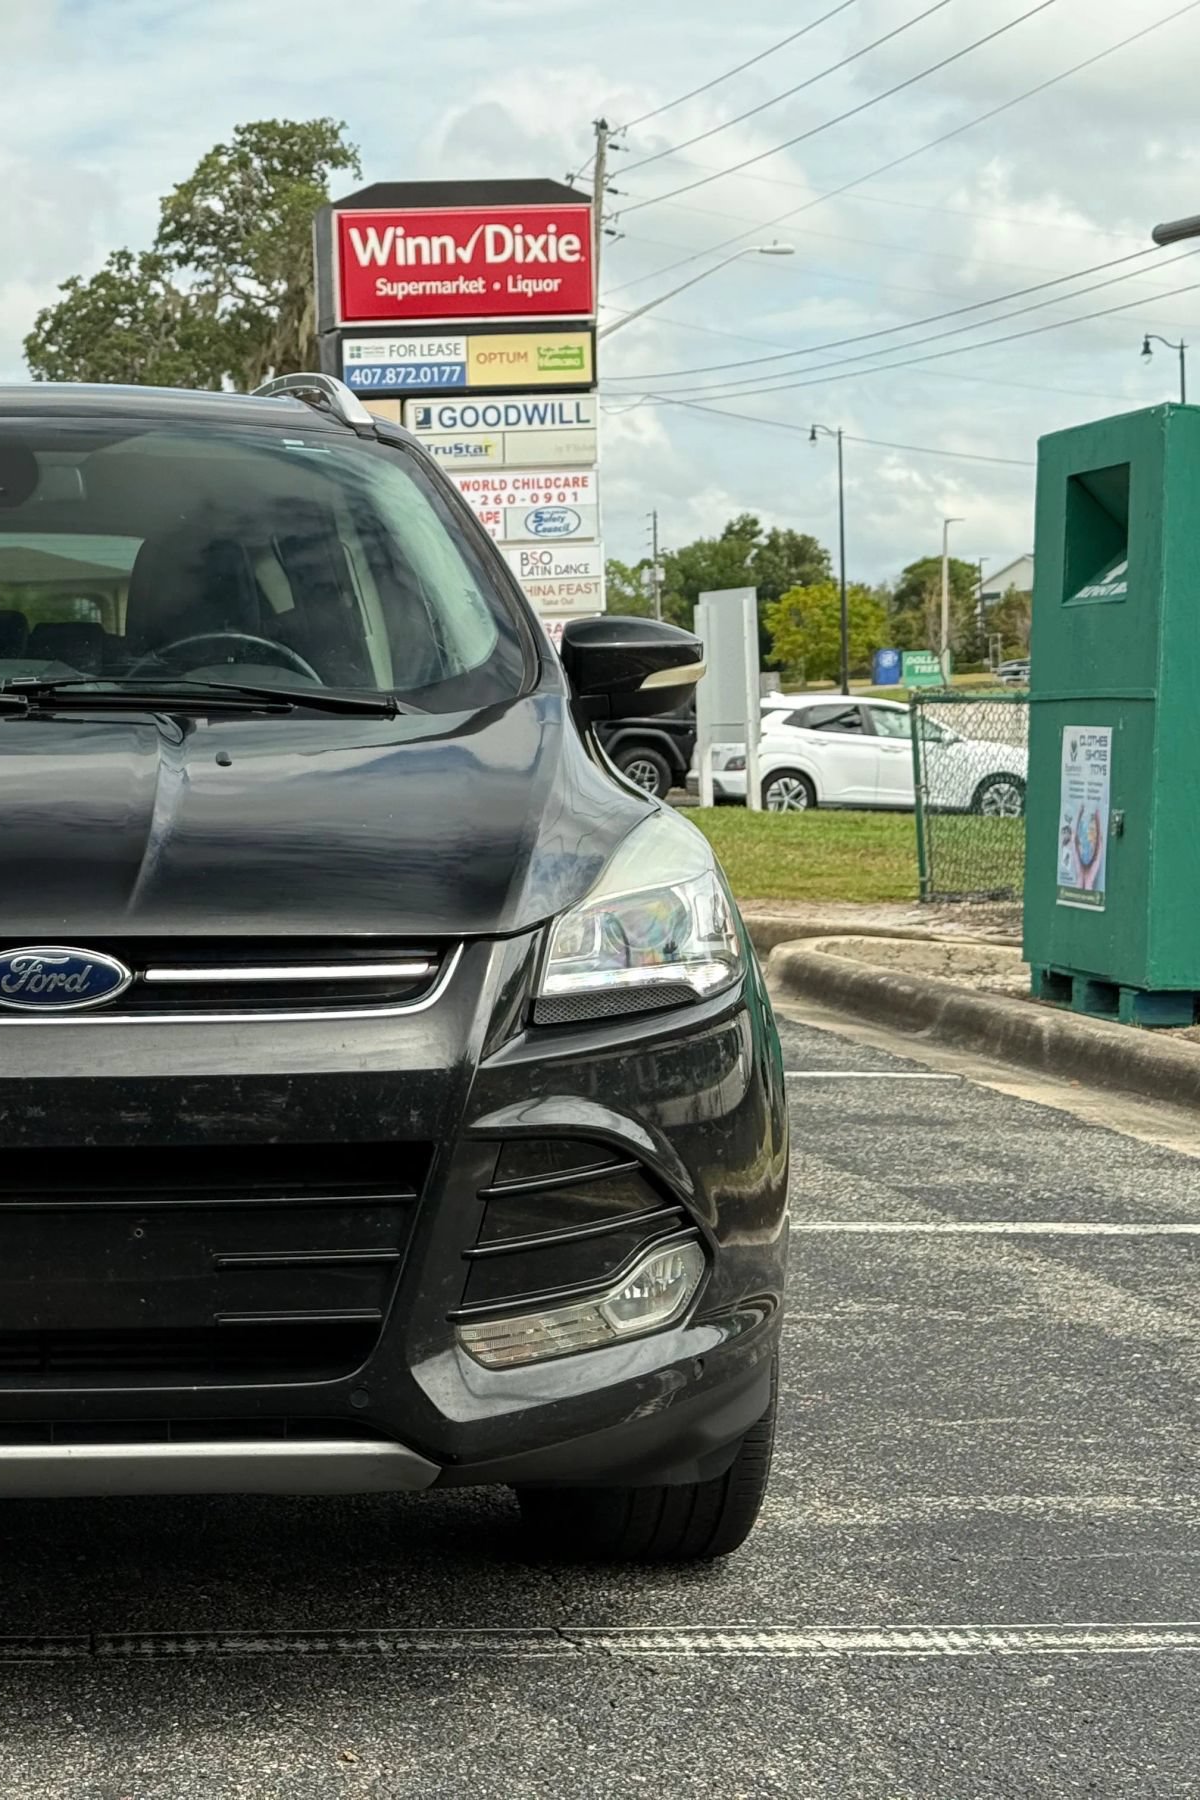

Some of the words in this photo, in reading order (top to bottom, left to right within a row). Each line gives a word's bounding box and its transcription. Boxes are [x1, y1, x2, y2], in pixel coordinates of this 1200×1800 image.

[375, 275, 486, 300] Supermarket
[507, 275, 562, 298] Liquor
[389, 344, 417, 358] FOR
[420, 342, 461, 357] LEASE
[476, 351, 528, 365] OPTUM
[350, 365, 462, 385] 407.872.0177
[438, 402, 591, 429] GOODWILL
[425, 443, 492, 455] TruStar
[460, 479, 507, 491] WORLD
[512, 476, 589, 490] CHILDCARE
[532, 511, 566, 524] Safety
[534, 522, 571, 533] Council
[520, 550, 553, 566] BSO
[520, 565, 552, 577] LATIN
[554, 563, 590, 575] DANCE
[524, 584, 555, 597] HINA
[558, 582, 600, 595] FEAST
[1079, 735, 1108, 747] CLOTHES
[1085, 749, 1107, 761] SHOES
[1090, 764, 1107, 777] TOYS
[0, 955, 93, 993] Ford
